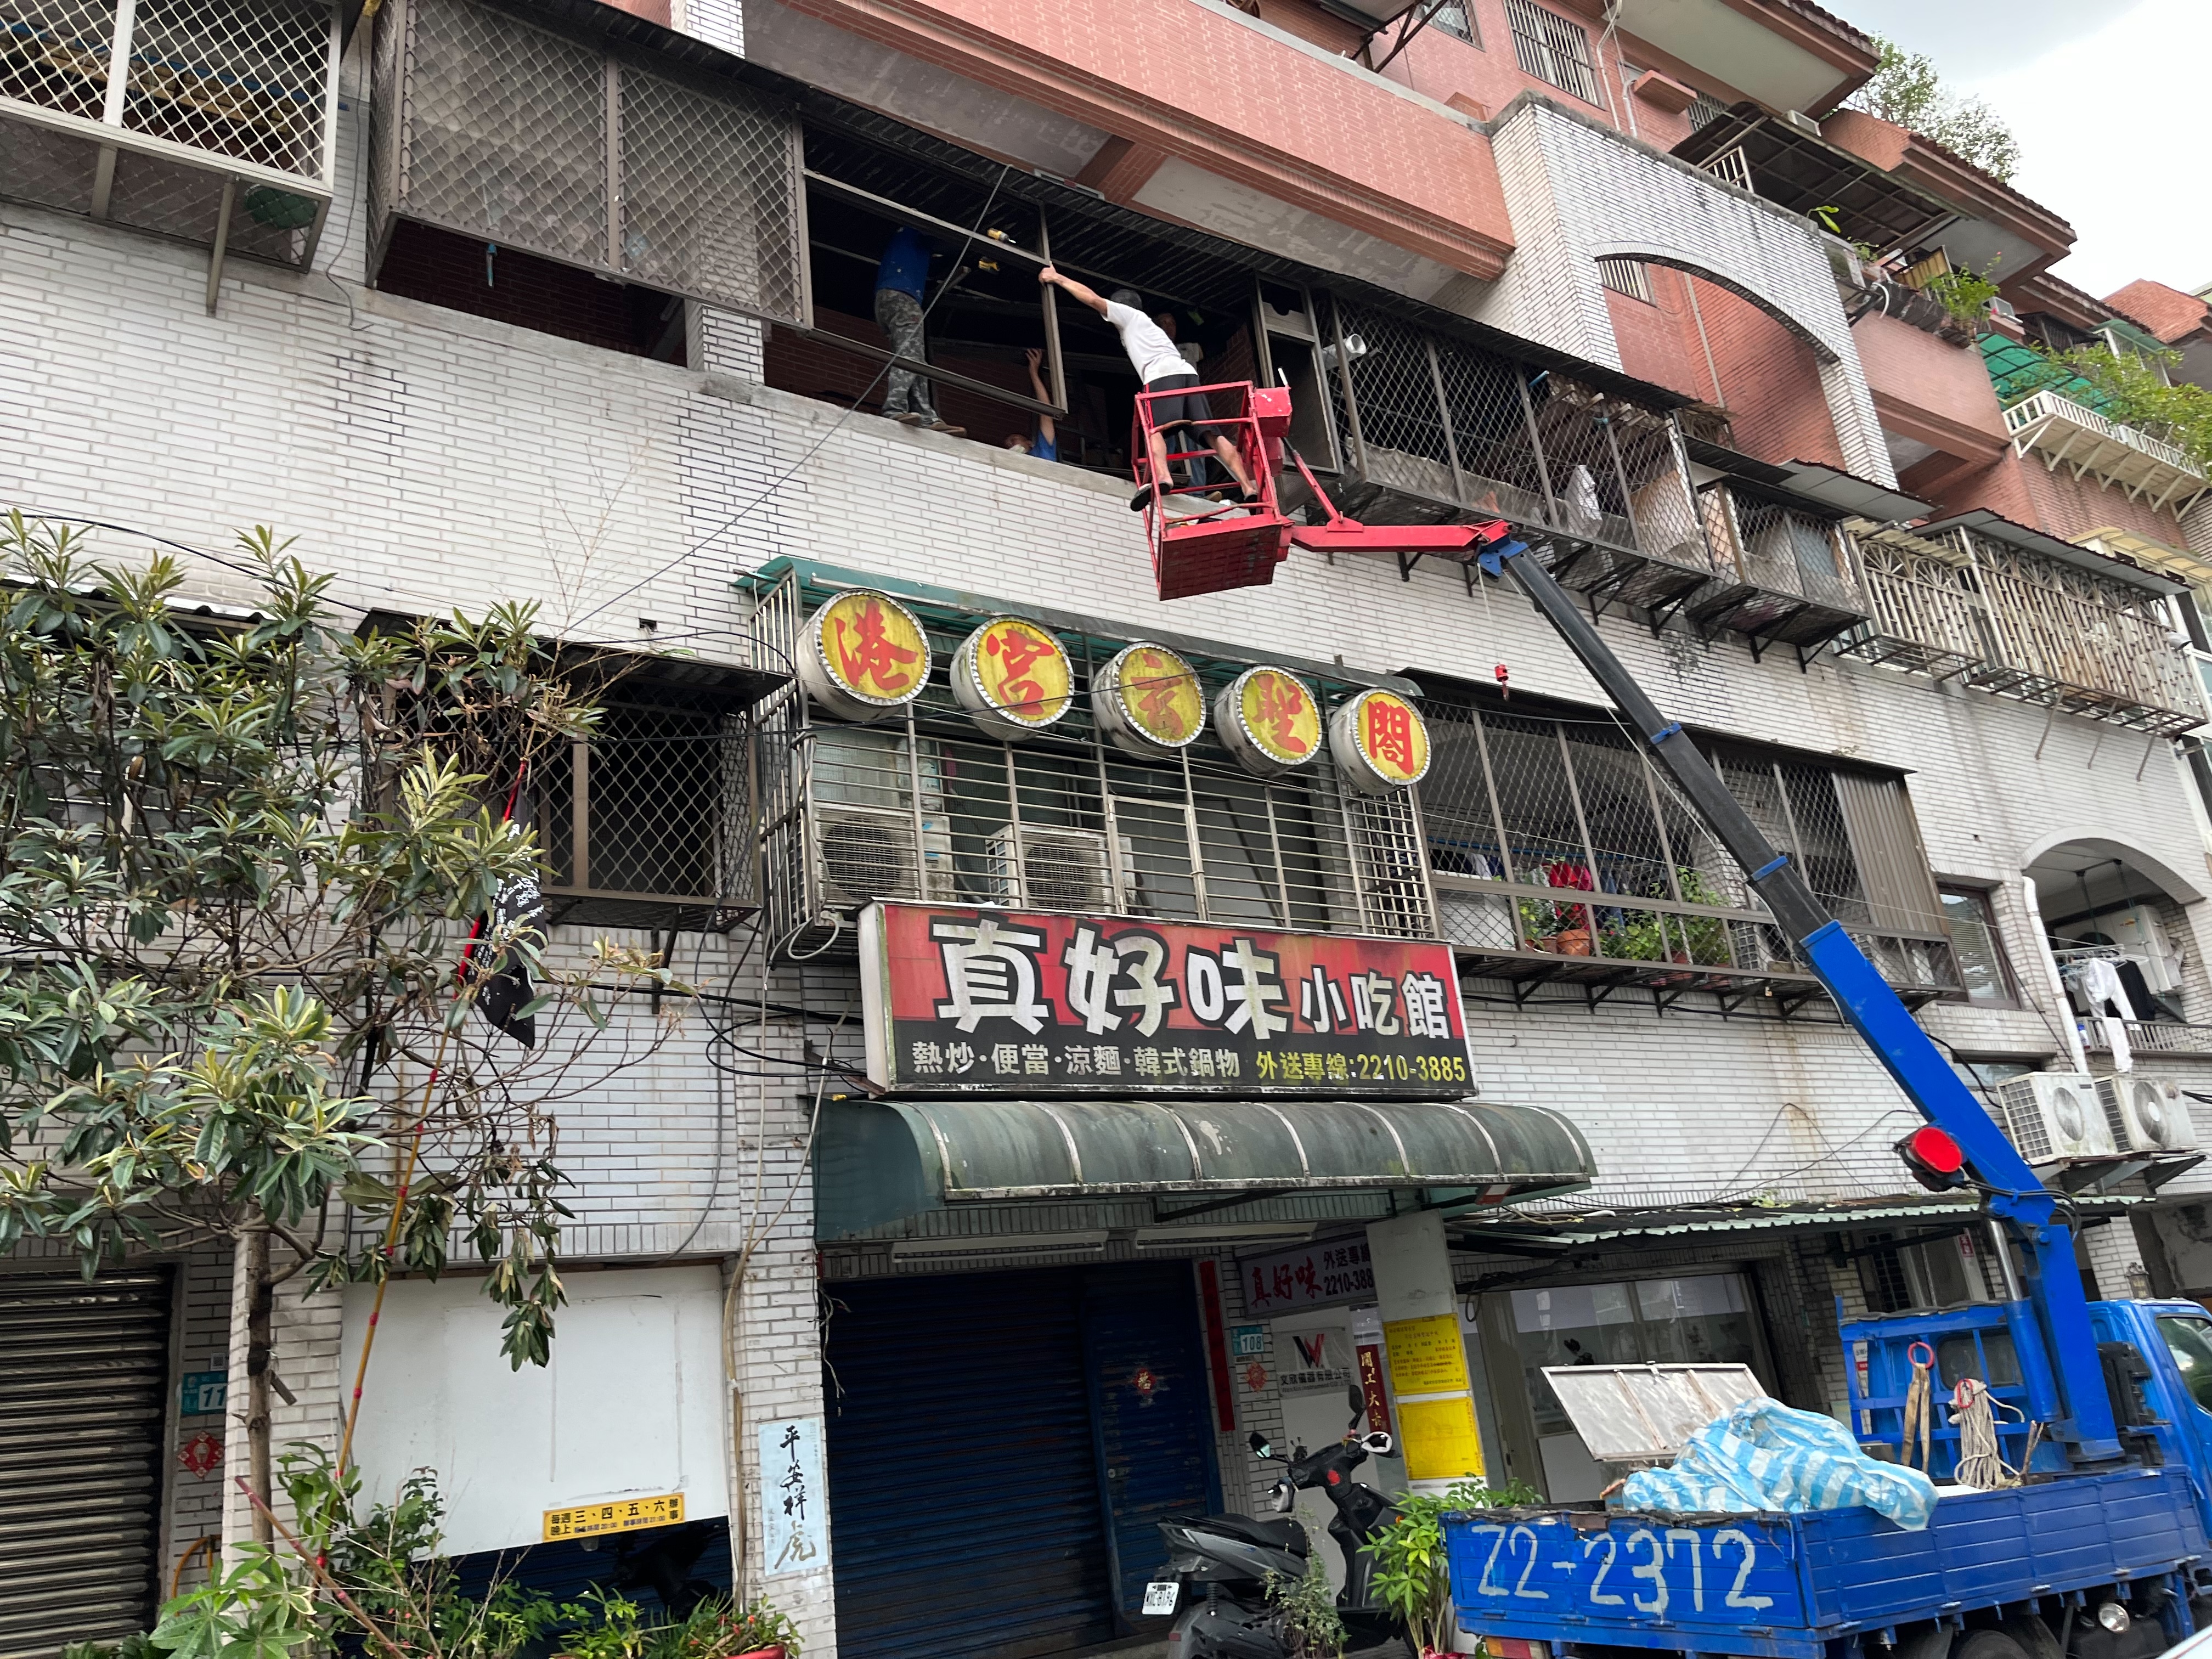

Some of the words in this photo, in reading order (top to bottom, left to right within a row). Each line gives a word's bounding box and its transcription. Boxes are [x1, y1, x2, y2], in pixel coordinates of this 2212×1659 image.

[931, 918, 1451, 1040] 真好味小吃館
[1251, 1256, 1323, 1308] 真好味
[1243, 1336, 1262, 1351] 108
